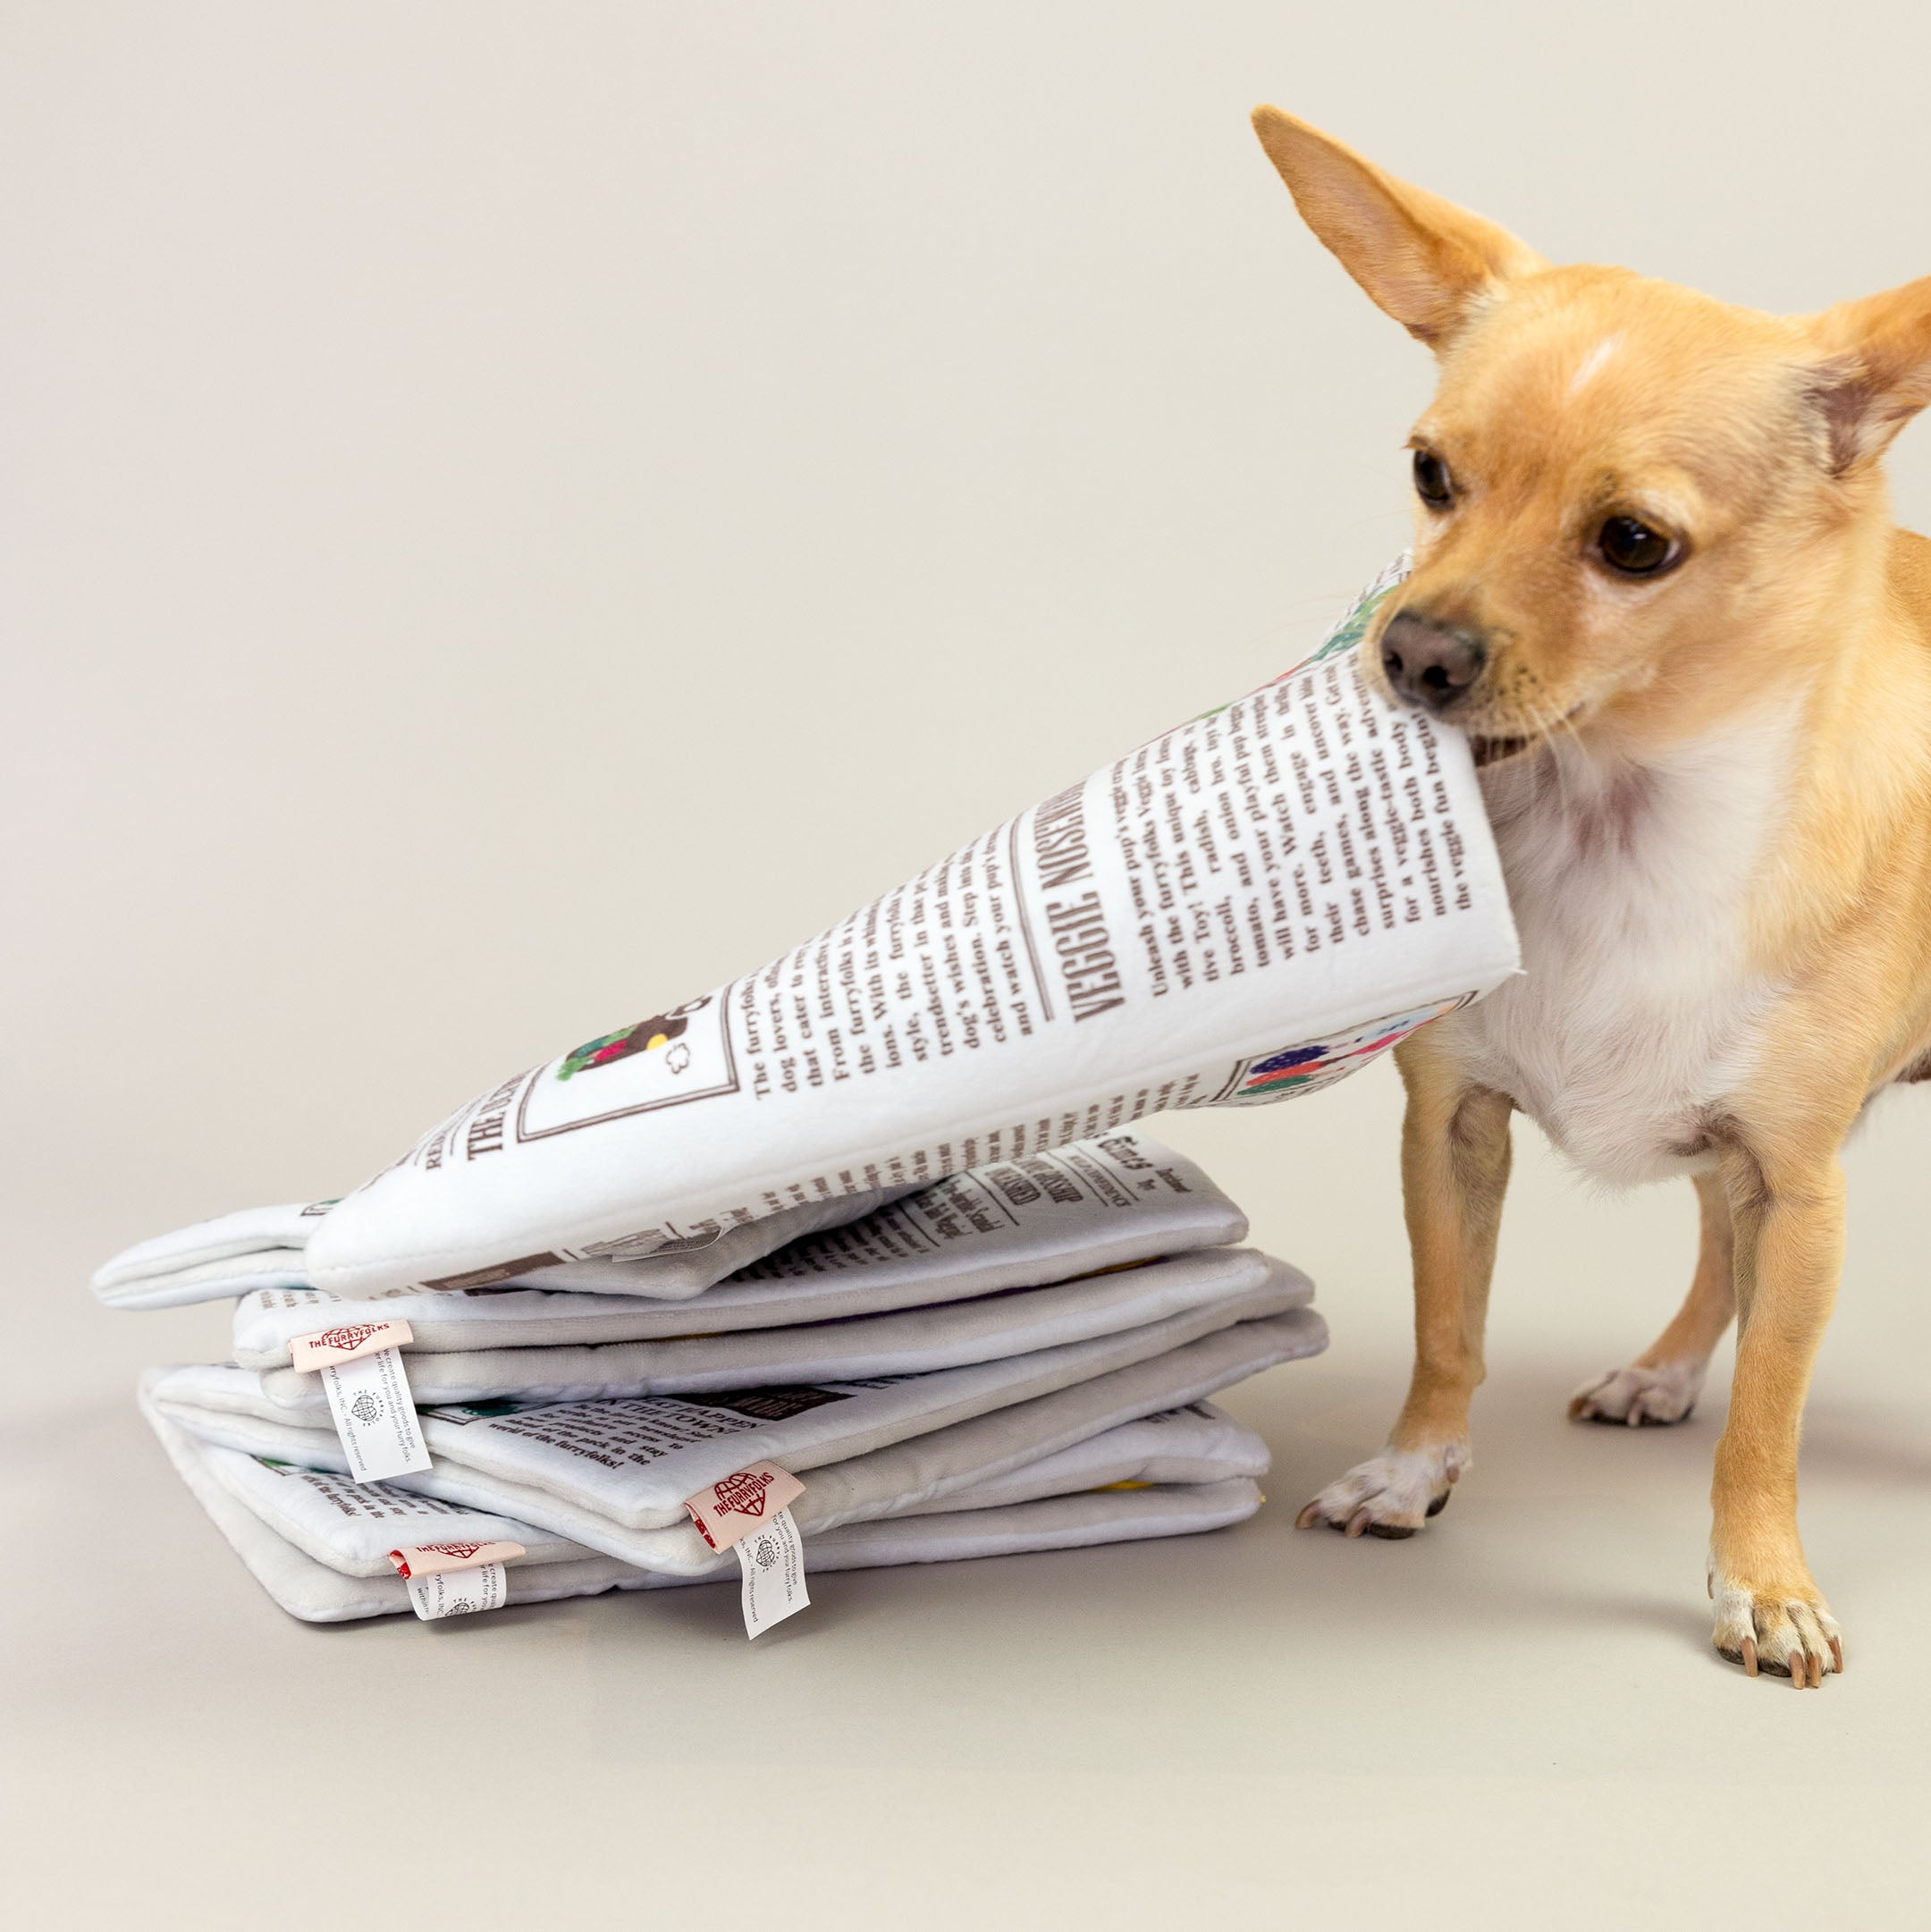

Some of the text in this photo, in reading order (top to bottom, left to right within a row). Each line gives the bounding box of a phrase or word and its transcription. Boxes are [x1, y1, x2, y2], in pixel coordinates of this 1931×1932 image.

[1335, 708, 1352, 746] way.
[1345, 753, 1362, 781] the
[1218, 791, 1240, 840] onion
[1304, 702, 1370, 936] chase games, and uncover
[1354, 786, 1376, 840] along
[1390, 721, 1446, 915] nourishes both body
[1433, 780, 1449, 814] fun
[1115, 825, 1142, 871] pup's
[1232, 735, 1294, 959] will have your playful pup
[1261, 744, 1320, 952] for more. Watch them
[1281, 724, 1344, 943] their teeth, engage in
[1370, 750, 1421, 923] for a veggie-tastic
[1439, 820, 1464, 878] veggie
[1134, 774, 1193, 989] with the furryfolks Veggie
[1160, 767, 1218, 982] tive Toy! This unique toy
[1193, 809, 1244, 975] broccoli, radish,
[1230, 851, 1252, 887] and
[1369, 846, 1395, 929] surprises
[1129, 876, 1153, 919] your
[1455, 883, 1471, 910] the
[957, 865, 1007, 1042] celebration. Step into
[981, 855, 1033, 1035] and watch your pup's
[1045, 890, 1126, 1023] VEGGIE
[1247, 897, 1269, 967] tomato,
[934, 900, 980, 1049] dog's wishes and
[1138, 924, 1168, 997] Unleash
[838, 935, 875, 1074] the furryfolks is
[864, 950, 902, 1067] ions. With its
[896, 972, 912, 1000] the
[914, 930, 954, 1056] trendsetter in
[789, 974, 823, 1087] that cater to
[814, 943, 850, 1081] From interactive
[905, 1012, 928, 1061] style,
[742, 981, 771, 1100] The furryfolks
[769, 992, 797, 1093] dog lovers,
[466, 1110, 505, 1160] THE
[308, 1322, 391, 1349] THE FURRYFOLKS
[376, 1360, 385, 1372] life
[380, 1373, 388, 1384] for
[382, 1385, 392, 1399] you
[384, 1356, 415, 1448] create quality goods to give
[387, 1400, 397, 1413] and
[621, 1403, 665, 1415] THE
[338, 1397, 367, 1471] INC. All rights reserved
[390, 1413, 401, 1430] your
[396, 1430, 406, 1446] furry
[489, 1423, 527, 1434] world
[535, 1435, 556, 1444] the
[554, 1441, 626, 1469] furryfolks!
[401, 1446, 410, 1462] folks.
[576, 1438, 611, 1449] pack
[611, 1447, 626, 1455] in
[628, 1453, 651, 1465] the
[609, 1436, 637, 1445] and
[639, 1445, 670, 1457] stay
[713, 1472, 775, 1516] THE FURRYFOLKS
[744, 1547, 753, 1563] INC.
[774, 1525, 785, 1540] you
[780, 1519, 793, 1543] quality
[791, 1563, 797, 1572] to
[781, 1540, 789, 1554] and
[480, 1570, 489, 1582] life
[485, 1567, 497, 1591] create
[784, 1567, 794, 1584] furry
[748, 1593, 758, 1623] reserved
